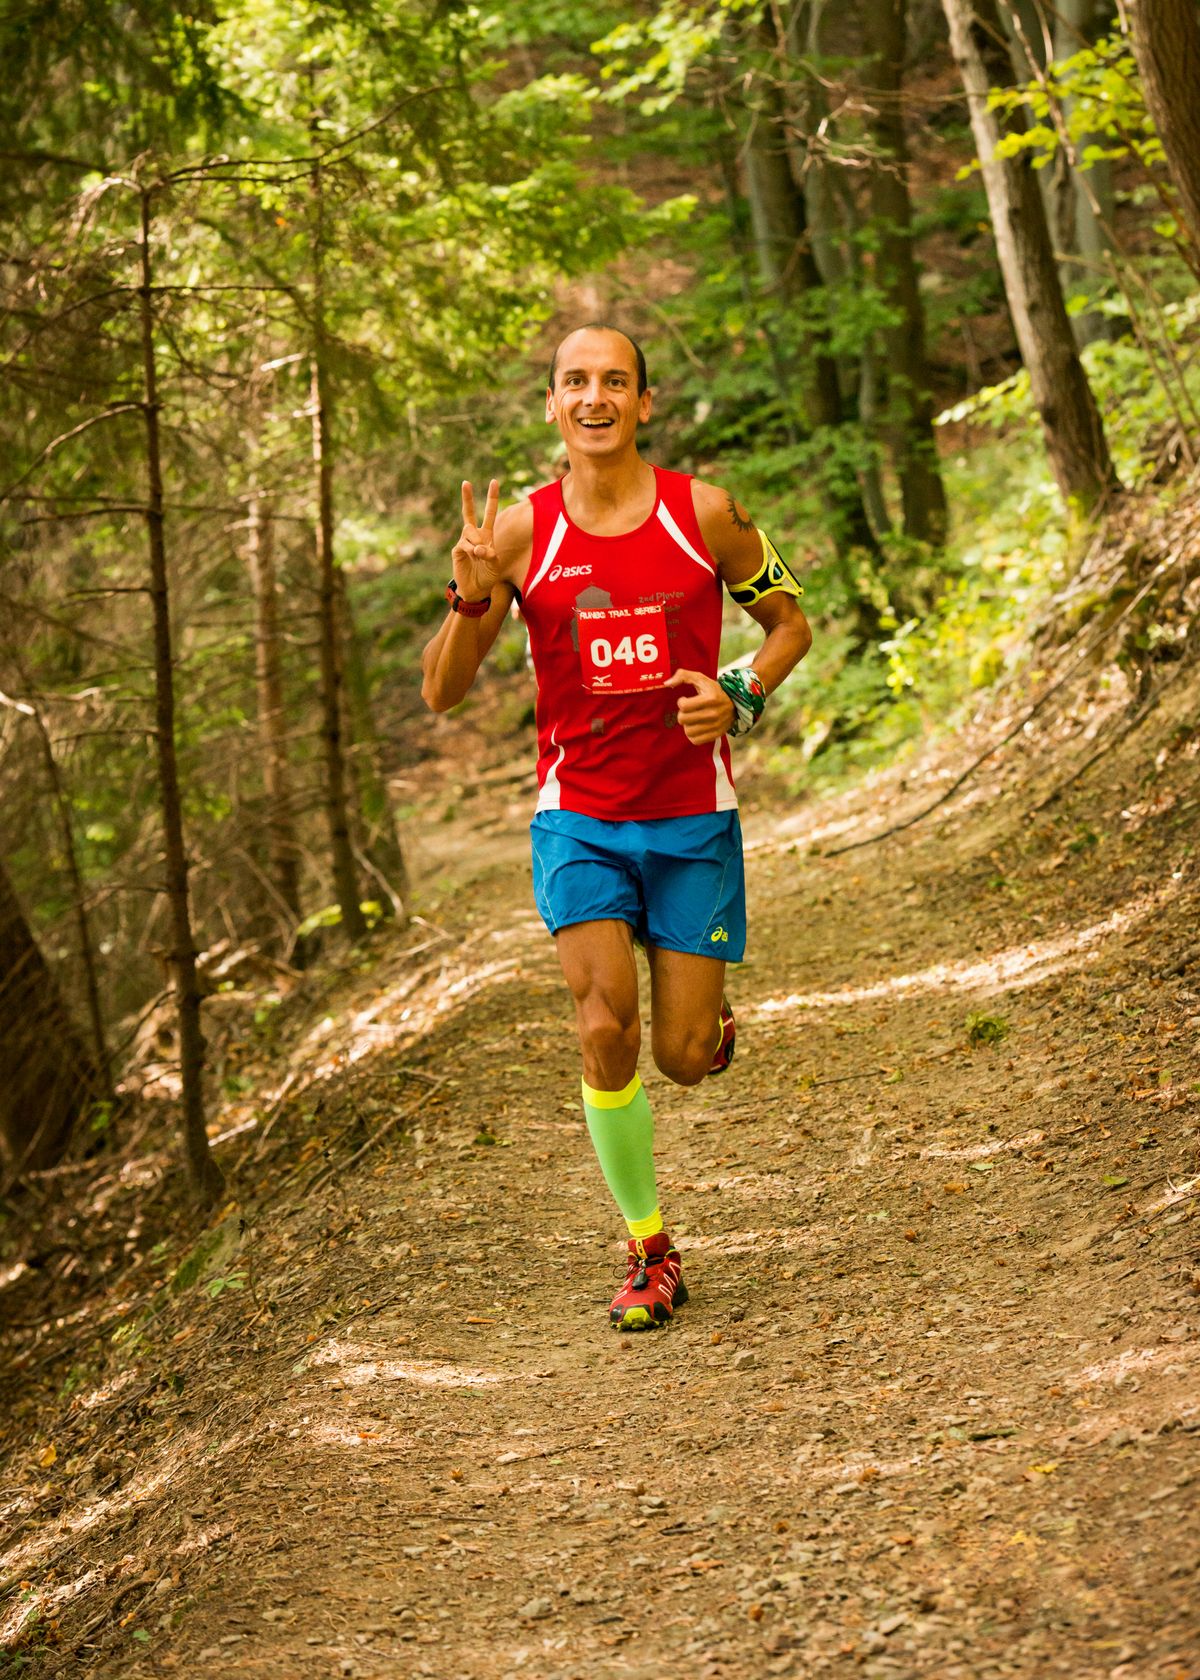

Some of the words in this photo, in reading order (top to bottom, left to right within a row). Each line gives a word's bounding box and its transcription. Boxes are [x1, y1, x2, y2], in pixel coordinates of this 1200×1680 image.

[638, 594, 655, 604] 2nd
[608, 609, 631, 618] TRAIL
[590, 633, 659, 668] 046
